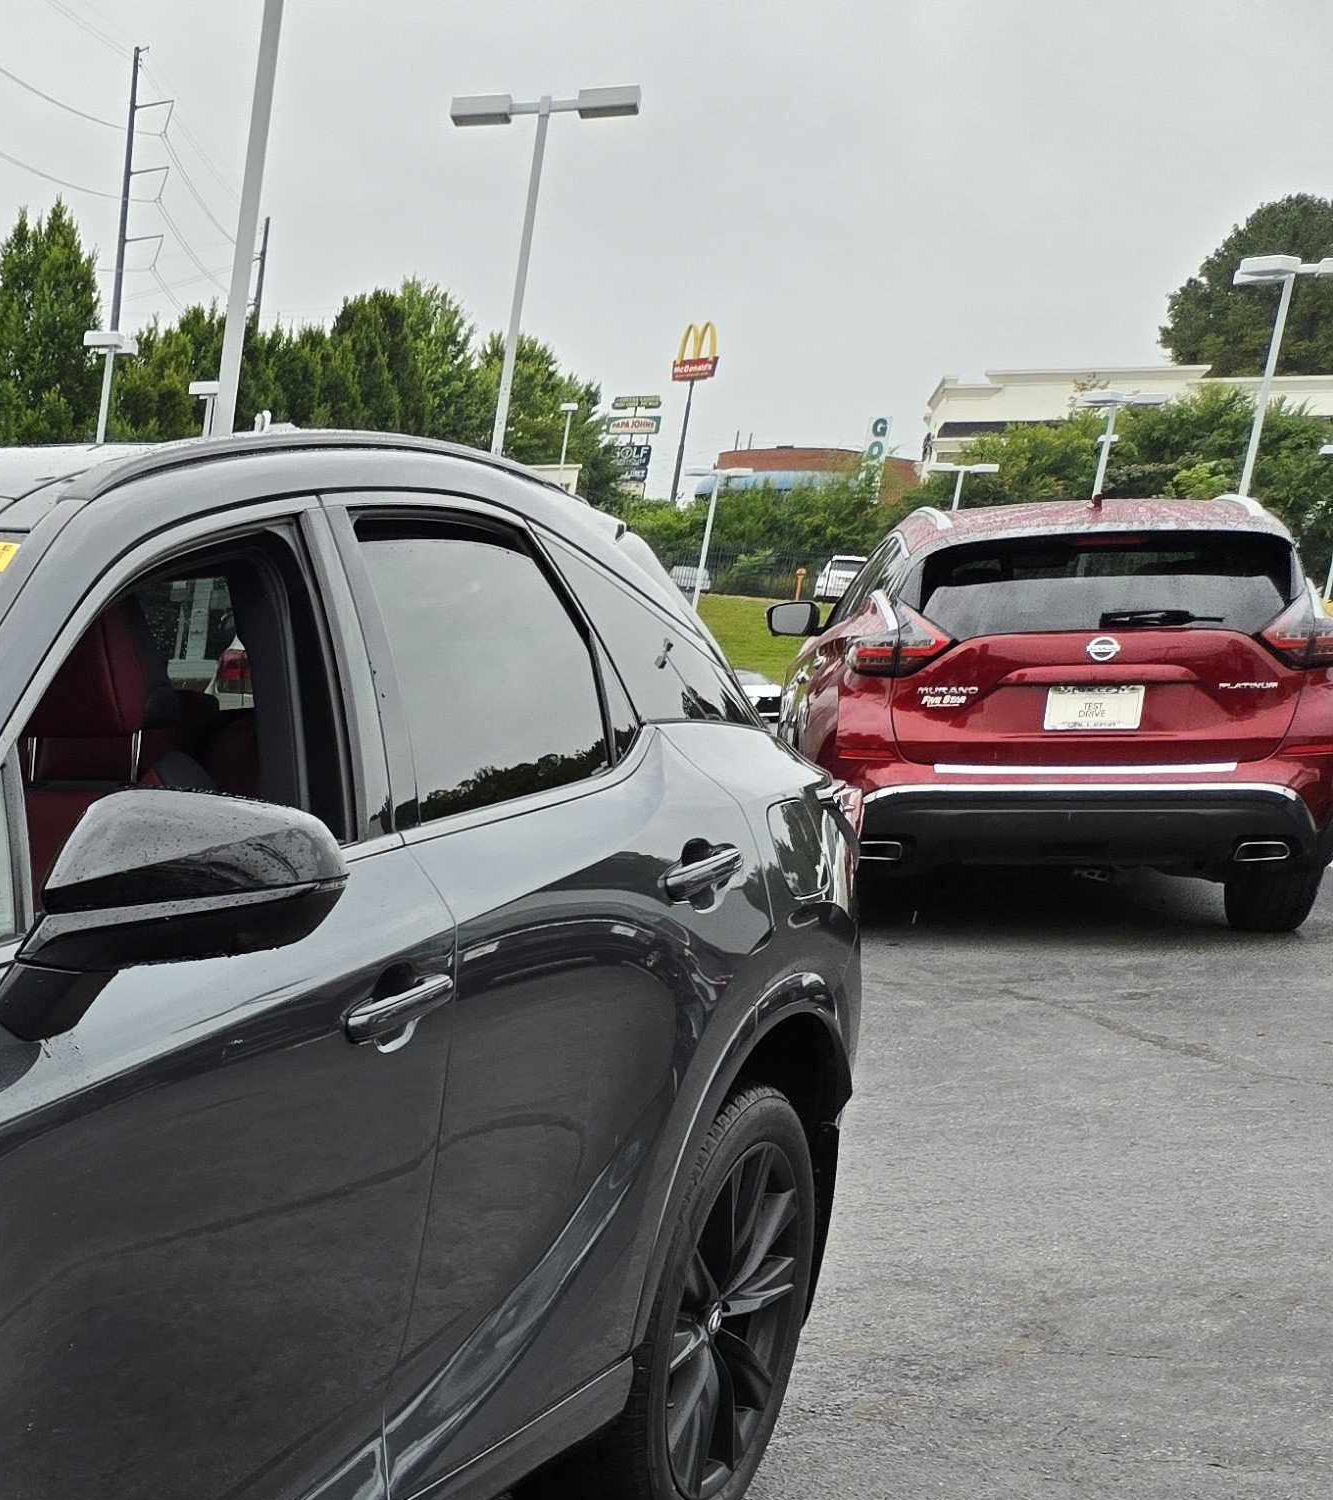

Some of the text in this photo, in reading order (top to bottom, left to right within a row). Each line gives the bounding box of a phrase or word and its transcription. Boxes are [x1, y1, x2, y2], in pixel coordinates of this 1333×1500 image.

[612, 421, 630, 430] PAPA
[1218, 681, 1279, 690] PLATINUM
[917, 686, 979, 695] MURANO
[1083, 702, 1104, 710] TEST
[1078, 710, 1107, 718] DRIVE
